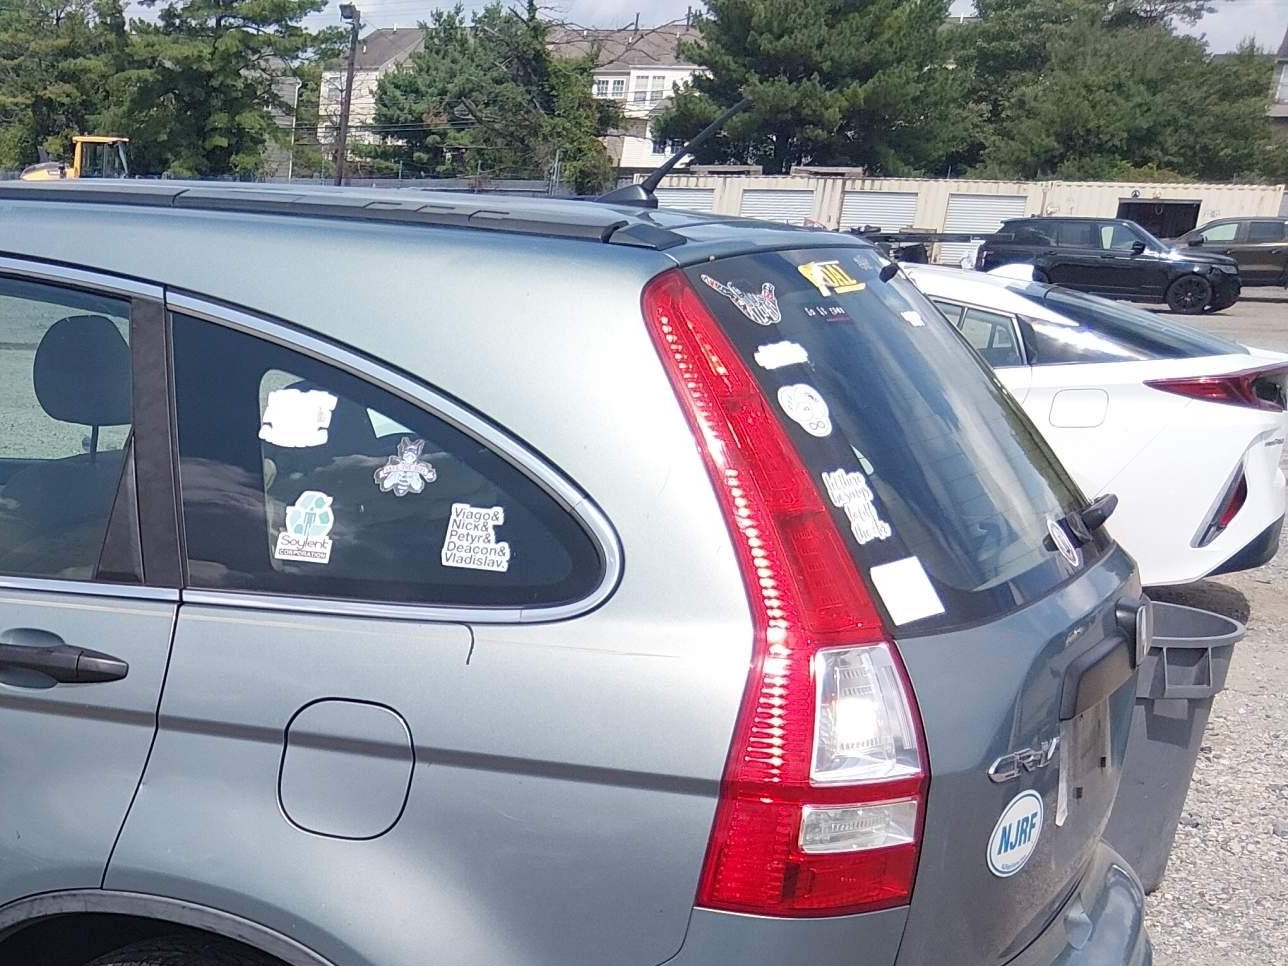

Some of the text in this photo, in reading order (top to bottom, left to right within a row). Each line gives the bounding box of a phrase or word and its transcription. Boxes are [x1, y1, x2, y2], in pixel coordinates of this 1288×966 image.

[455, 507, 500, 523] Viago&
[452, 518, 489, 532] Nick&
[280, 534, 329, 550] Soylent
[449, 530, 491, 545] Petyr&
[447, 541, 506, 557] Deacon&
[997, 811, 1038, 856] NJRF
